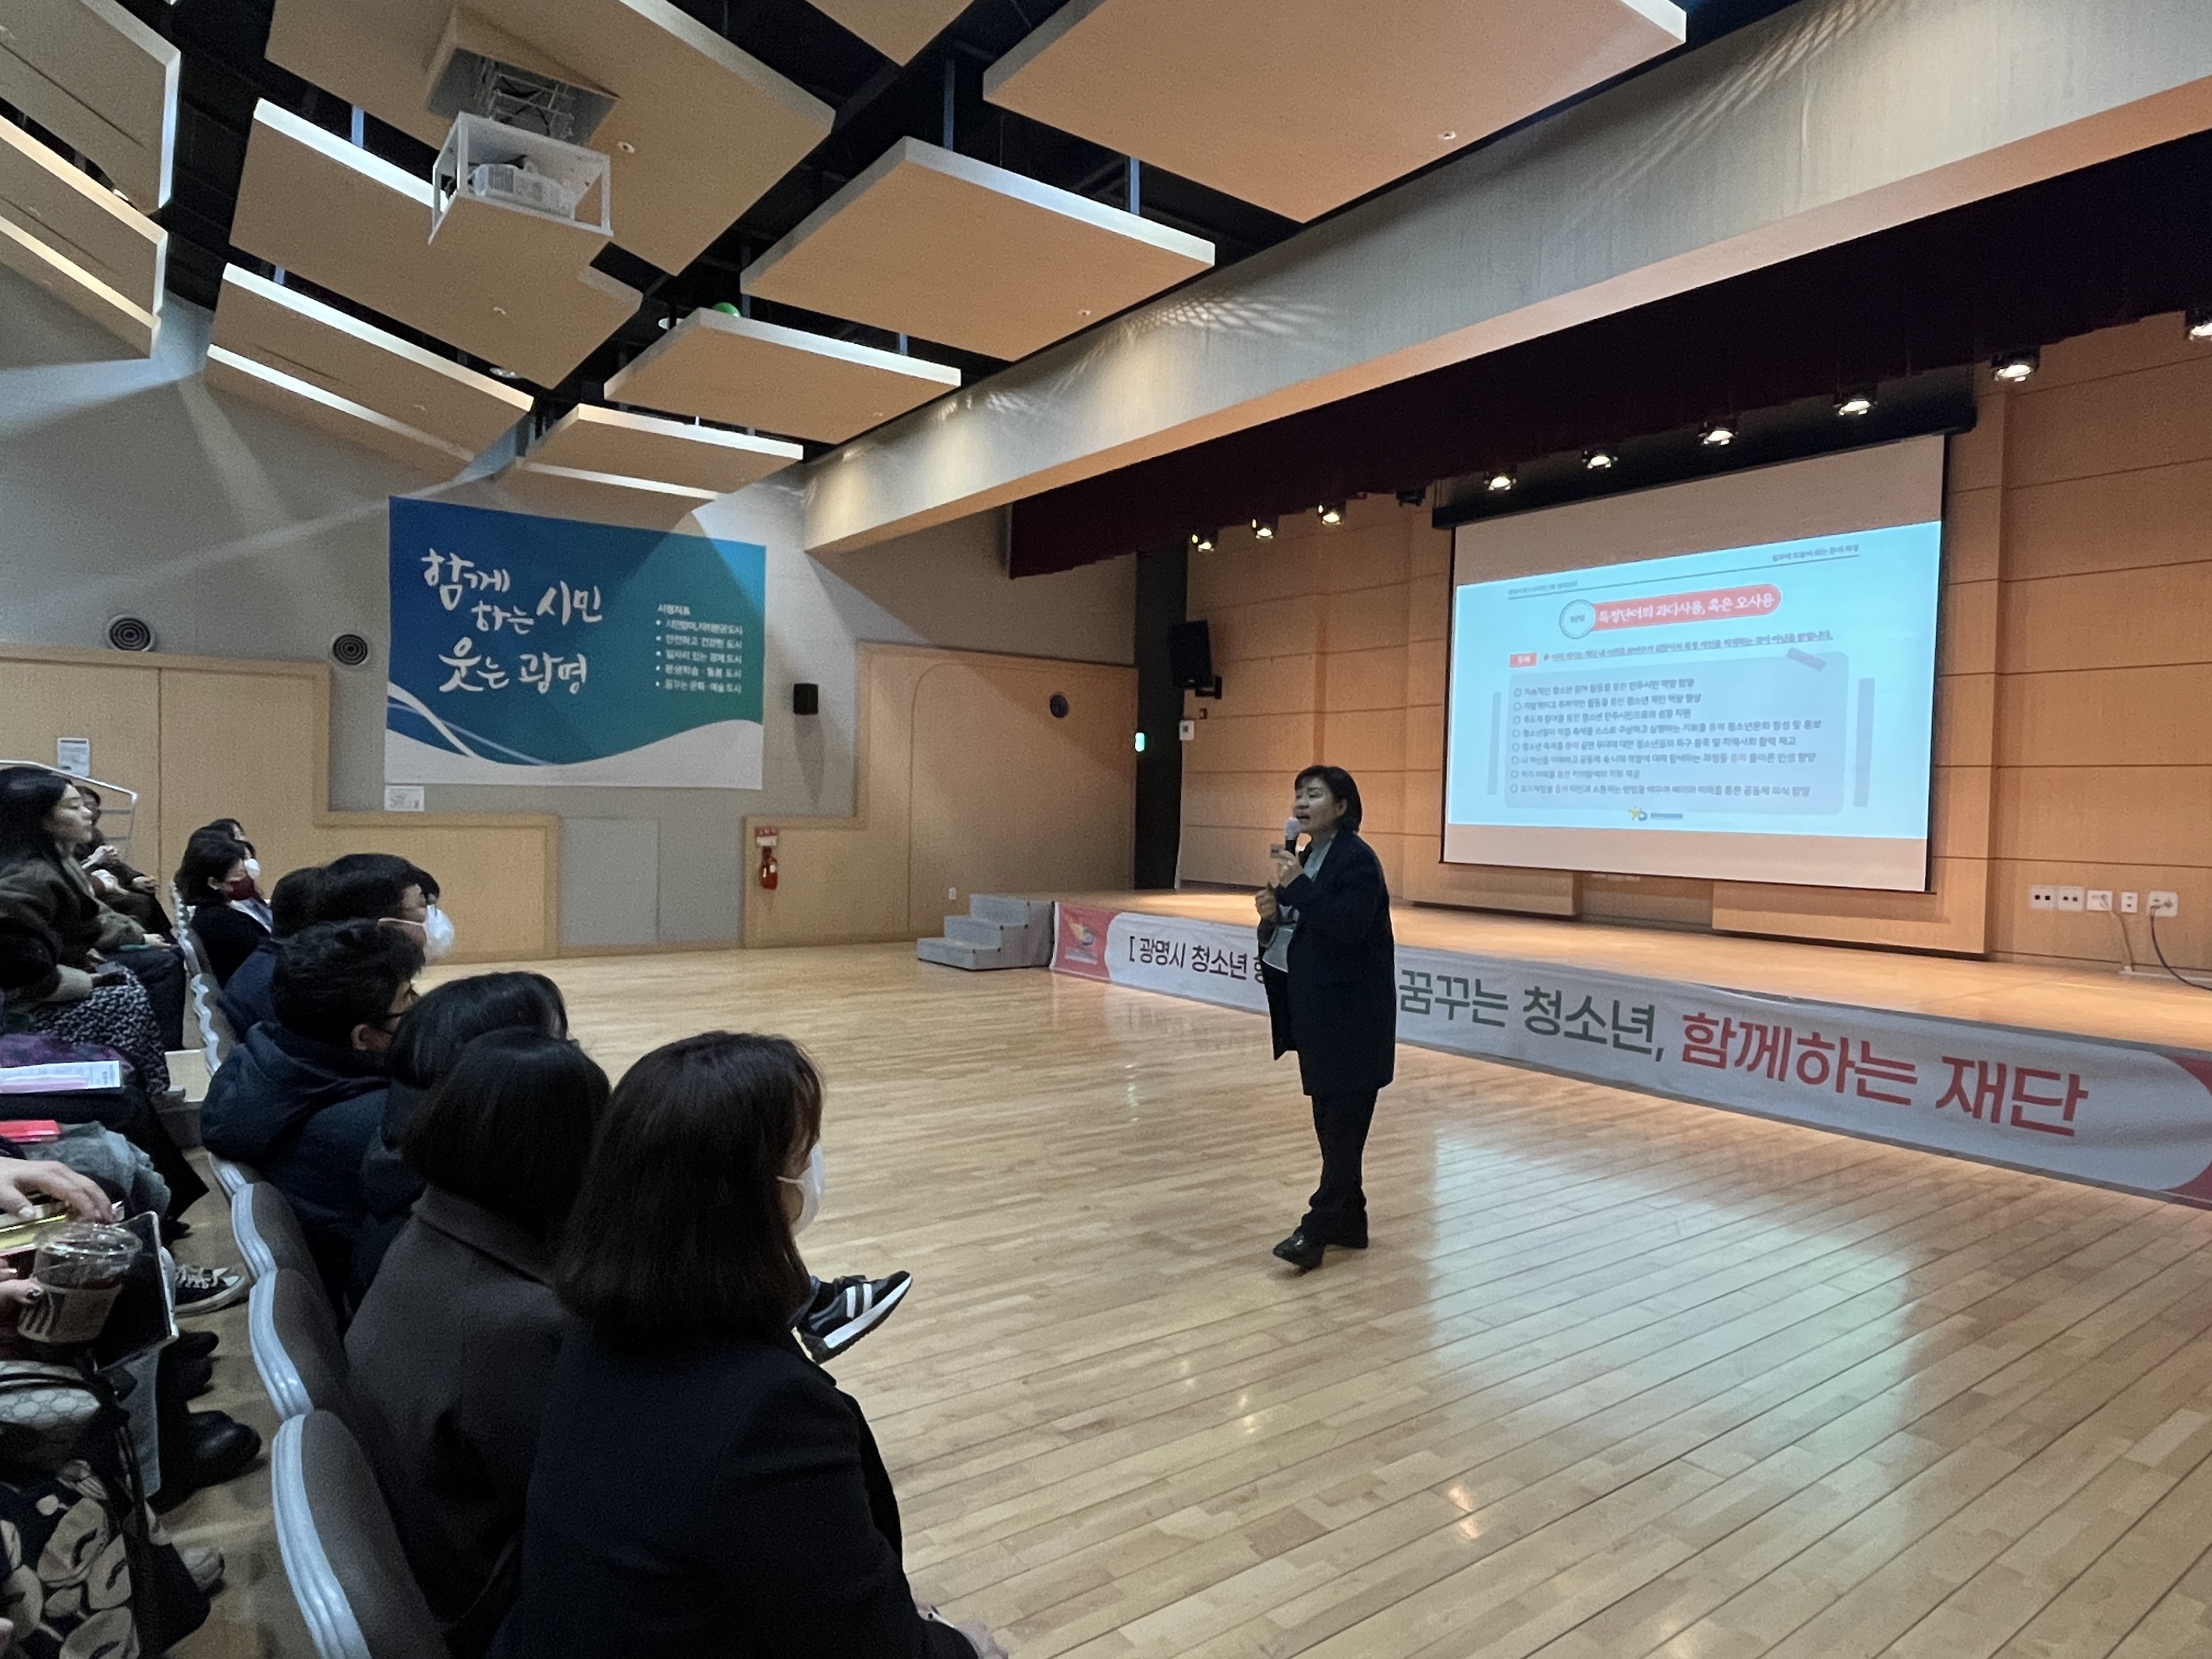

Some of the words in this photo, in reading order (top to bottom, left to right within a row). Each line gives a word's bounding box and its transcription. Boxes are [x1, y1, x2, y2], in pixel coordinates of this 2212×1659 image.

[421, 548, 511, 611] 함께
[471, 600, 534, 634] 하는
[536, 580, 602, 625] 시민
[438, 636, 510, 692] 웃는
[519, 651, 587, 695] 광명
[1139, 938, 1186, 969] 광명시
[1191, 944, 1248, 980] 청소년
[1398, 969, 1509, 1028] 꿈꾸는
[1522, 986, 1664, 1062] 청소년,
[1681, 1012, 1918, 1106] 함께하는
[1935, 1054, 2089, 1137] 재단
